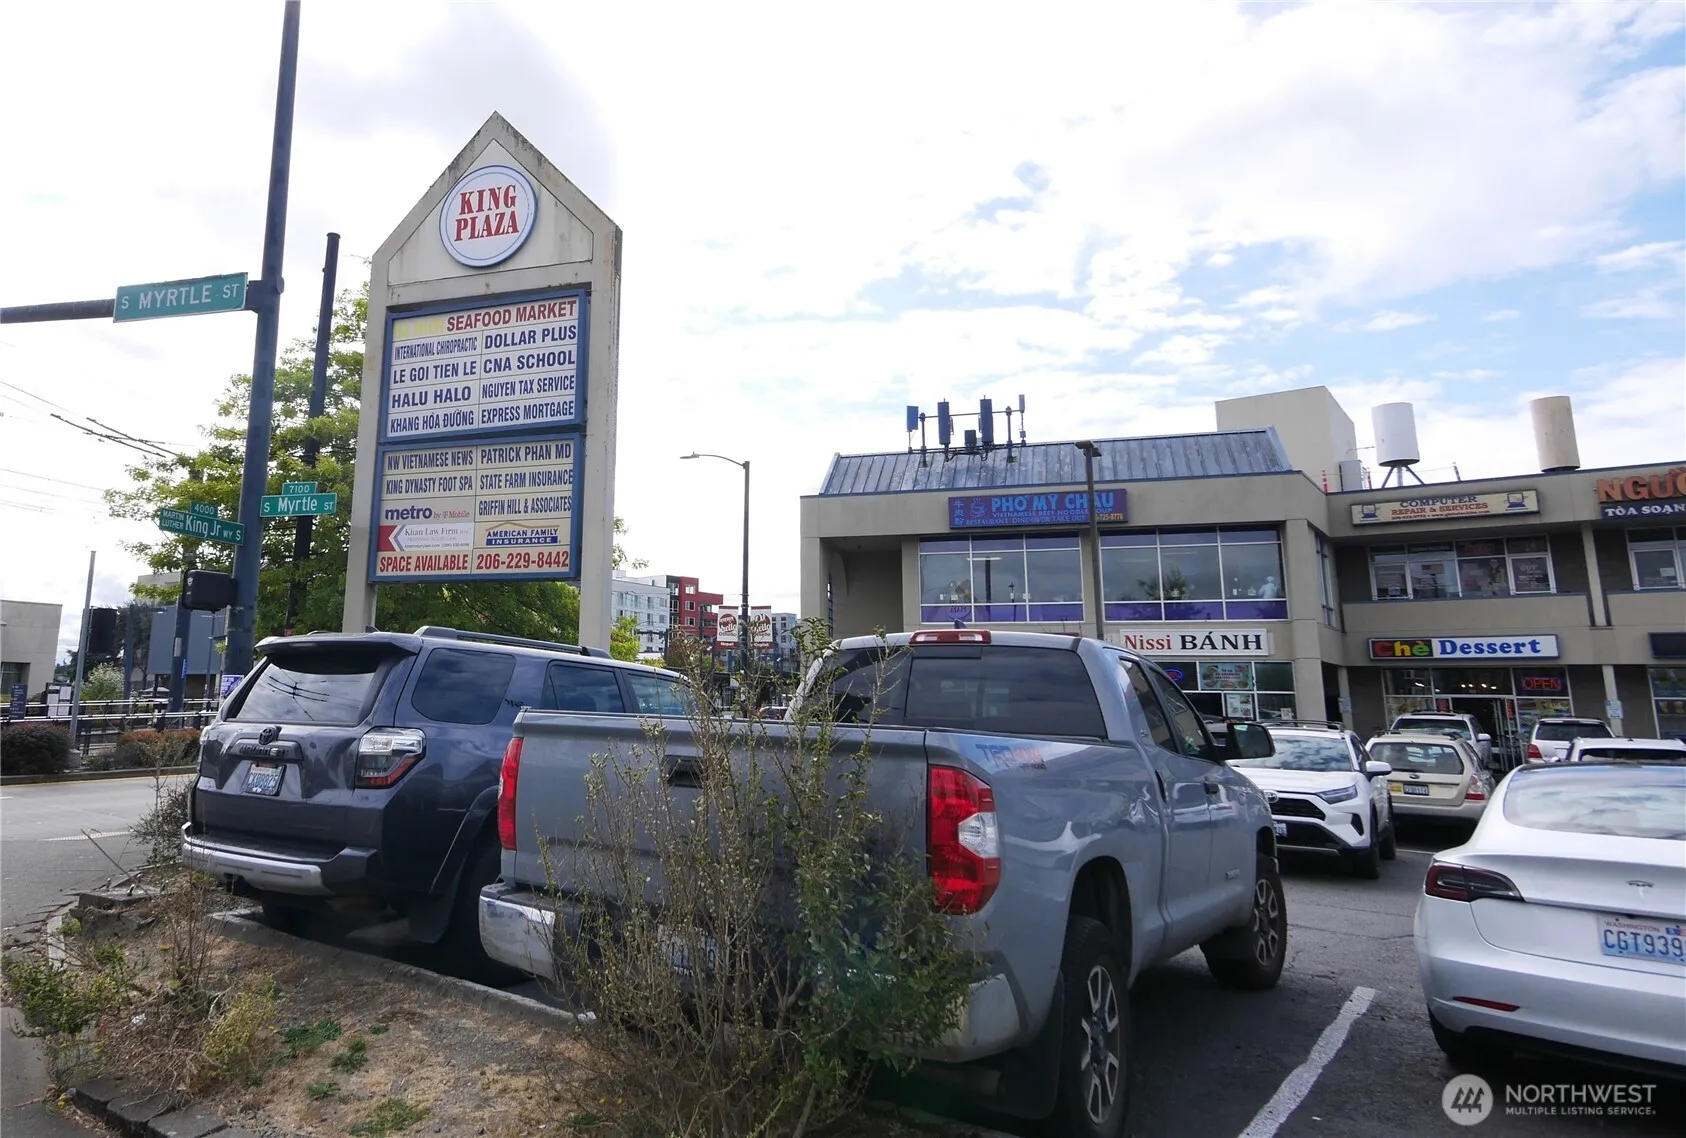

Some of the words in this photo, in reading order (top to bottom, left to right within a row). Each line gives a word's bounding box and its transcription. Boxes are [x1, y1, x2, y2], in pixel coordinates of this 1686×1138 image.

[459, 184, 517, 215] KING
[454, 211, 519, 242] PLAZA
[121, 296, 129, 309] S
[138, 285, 212, 309] MYRTLE
[222, 283, 240, 298] ST
[447, 308, 512, 332] SEAFOOD
[515, 300, 576, 323] MARKET
[484, 330, 536, 349] DOLLAR
[541, 325, 577, 343] PLUS
[394, 341, 435, 361] INTERNATIONAL
[436, 336, 478, 356] CHIROPRACTIC
[483, 357, 512, 374] CNA
[517, 350, 575, 370] SCHOOL
[393, 369, 406, 385] LE
[409, 366, 429, 382] GOI
[433, 363, 459, 379] TIEN
[463, 360, 477, 376] LE
[391, 390, 428, 409] HALU
[433, 385, 471, 404] HALO
[482, 381, 516, 399] NGUYEN
[518, 379, 534, 395] TAX
[537, 375, 575, 392] SERVICE
[481, 404, 521, 424] EXPRESS
[523, 400, 574, 420] MORTGAGE
[390, 416, 420, 433] KHANG
[387, 456, 400, 471] NW
[401, 452, 449, 470] VIETNAMESE
[451, 450, 473, 466] NEWS
[480, 446, 522, 465] PATRICK
[524, 444, 552, 462] PHAN
[555, 443, 571, 460] MD
[289, 485, 310, 493] 7100
[386, 479, 403, 495] KING
[404, 477, 436, 494] DYNASTY
[438, 476, 457, 492] FOOT
[459, 475, 473, 491] SPA
[479, 474, 502, 490] STATE
[504, 472, 526, 488] FARM
[528, 468, 573, 486] INSURANCE
[194, 504, 215, 515] 4000
[263, 502, 270, 512] S
[278, 496, 317, 515] Myrtle
[323, 502, 334, 510] ST
[478, 499, 505, 516] GRIFFIN
[507, 498, 521, 514] HILL
[523, 498, 529, 512] &
[530, 495, 572, 513] ASSOCIATES
[1391, 507, 1427, 516] REPAIR
[1439, 502, 1489, 512] SERVICES
[1400, 495, 1478, 508] COMPUTER
[163, 510, 184, 521] MARTIN
[385, 505, 432, 520] metro
[433, 511, 441, 520] by
[161, 519, 184, 530] LUTHER
[185, 514, 209, 538] King
[209, 520, 221, 537] Jr
[223, 529, 233, 539] WY
[235, 529, 242, 541] S
[405, 528, 423, 536] Khan
[441, 527, 458, 535] Firm
[487, 530, 528, 538] AMERICAN
[530, 528, 558, 536] FAMILY
[379, 555, 412, 573] SPACE
[414, 553, 468, 572] AVAILABLE
[476, 550, 569, 570] 206-229-8442
[1124, 635, 1171, 650] Nissi
[1180, 631, 1263, 650] BÁNH
[1374, 640, 1430, 657] Chè
[1438, 639, 1541, 655] Dessert
[1524, 677, 1559, 689] OPEN
[1604, 920, 1661, 932] WASHINGTON
[1603, 929, 1683, 957] CGT939
